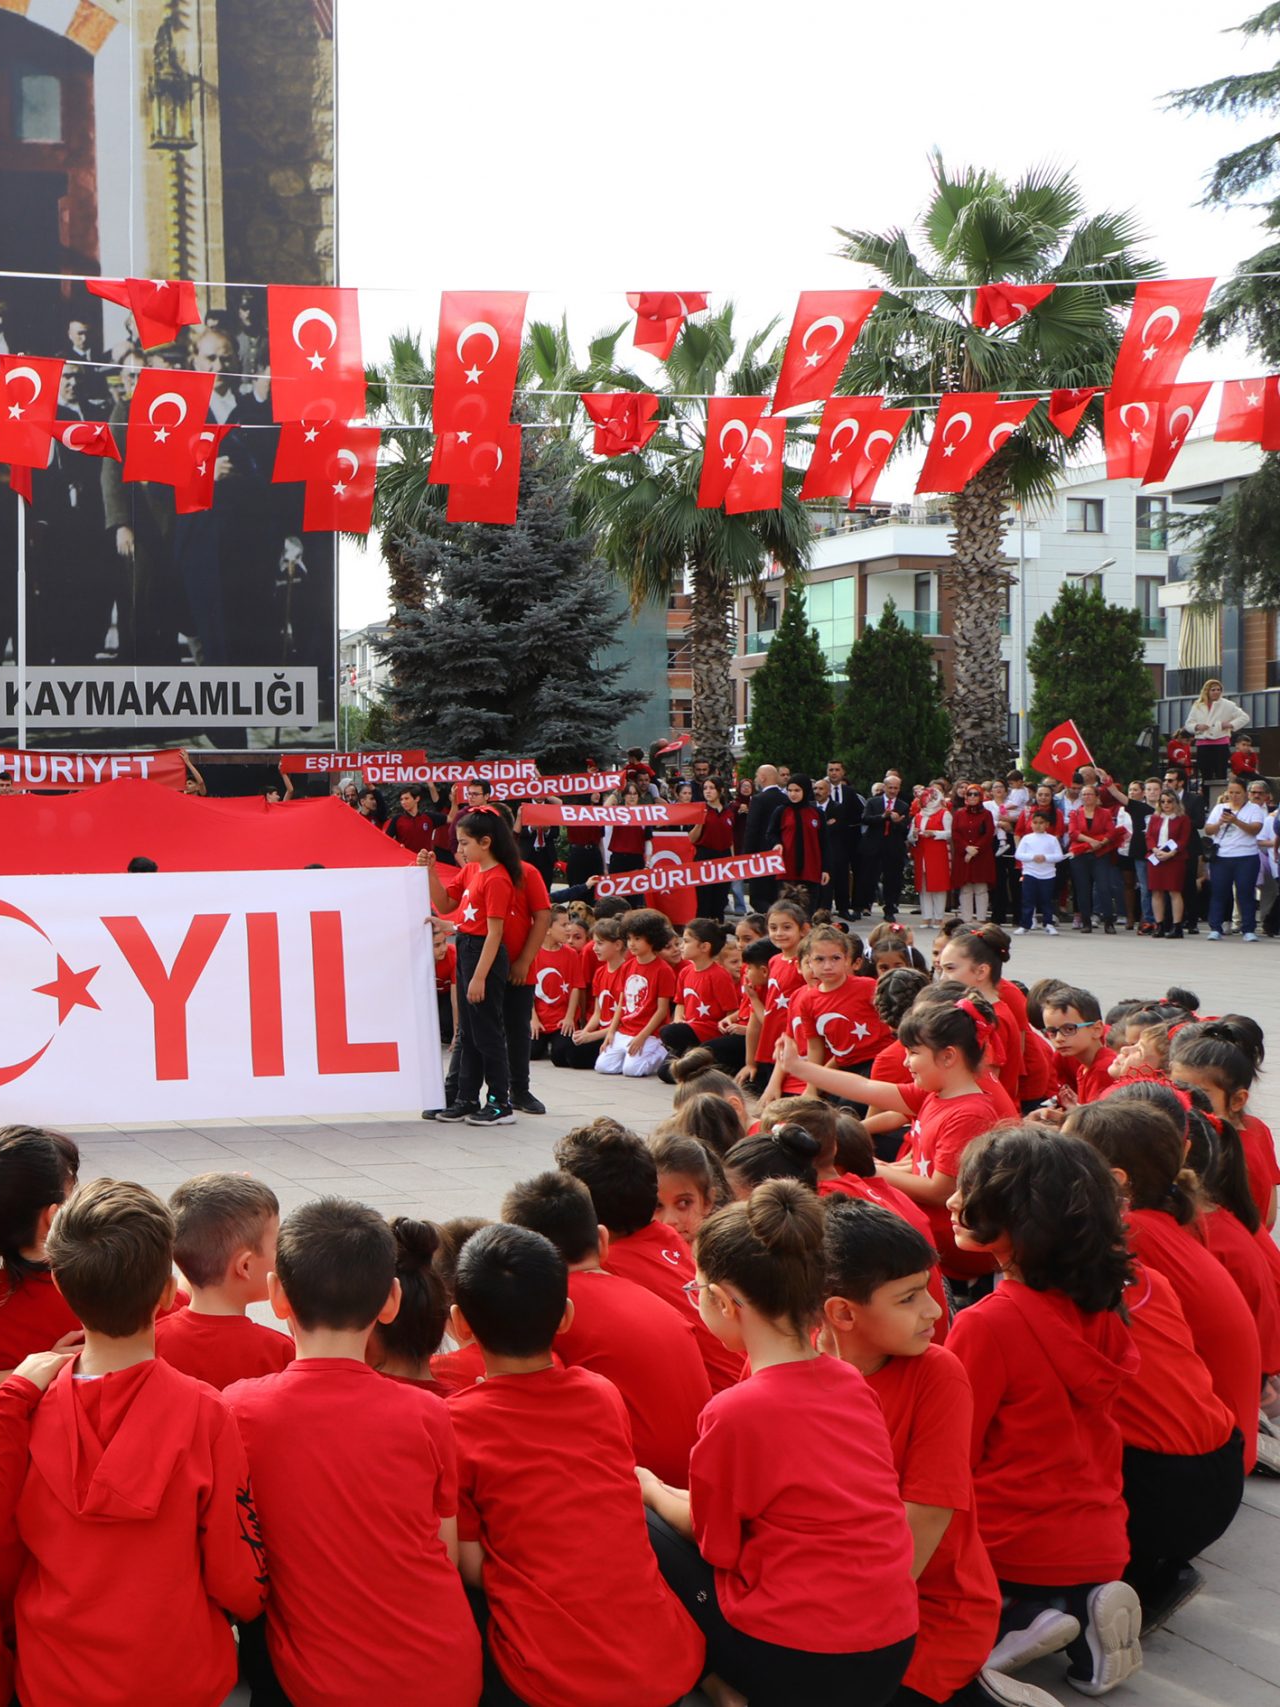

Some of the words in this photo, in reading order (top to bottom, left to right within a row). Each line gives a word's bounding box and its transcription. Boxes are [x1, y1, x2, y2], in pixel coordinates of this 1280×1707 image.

[5, 672, 305, 716] KAYMAKAMLIĞI
[305, 751, 403, 772] EŞİTLİKTİR
[367, 760, 536, 782] DEMOKRASİDİR
[560, 805, 669, 824] BARIŞTIR
[596, 853, 786, 898] ÖZGÜRLÜKTÜR
[100, 910, 401, 1082] YIL
